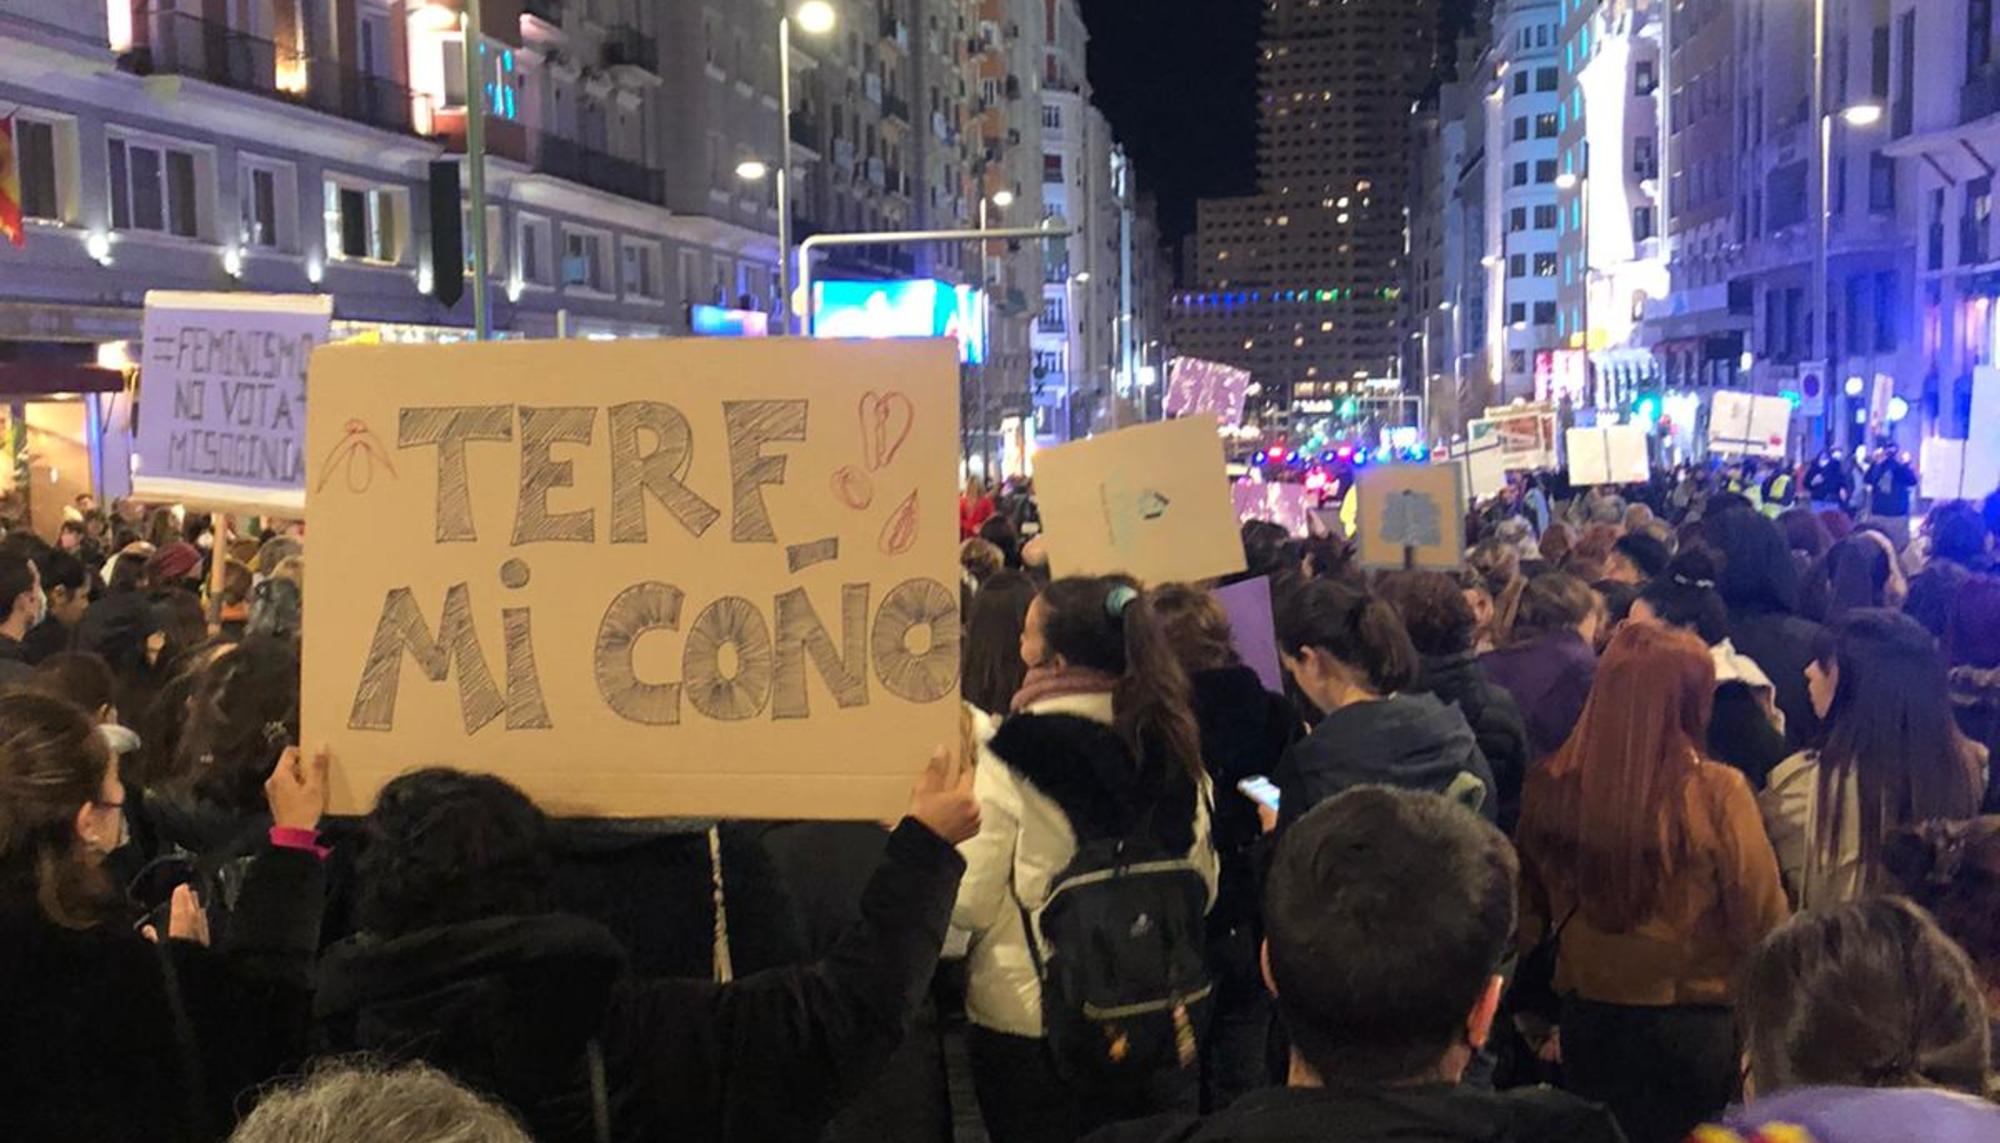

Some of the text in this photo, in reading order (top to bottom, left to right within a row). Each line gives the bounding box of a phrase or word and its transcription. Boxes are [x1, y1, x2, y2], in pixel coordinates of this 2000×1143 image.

[174, 380, 205, 421] NO
[398, 399, 809, 546] TERF
[594, 537, 961, 726] COÑO
